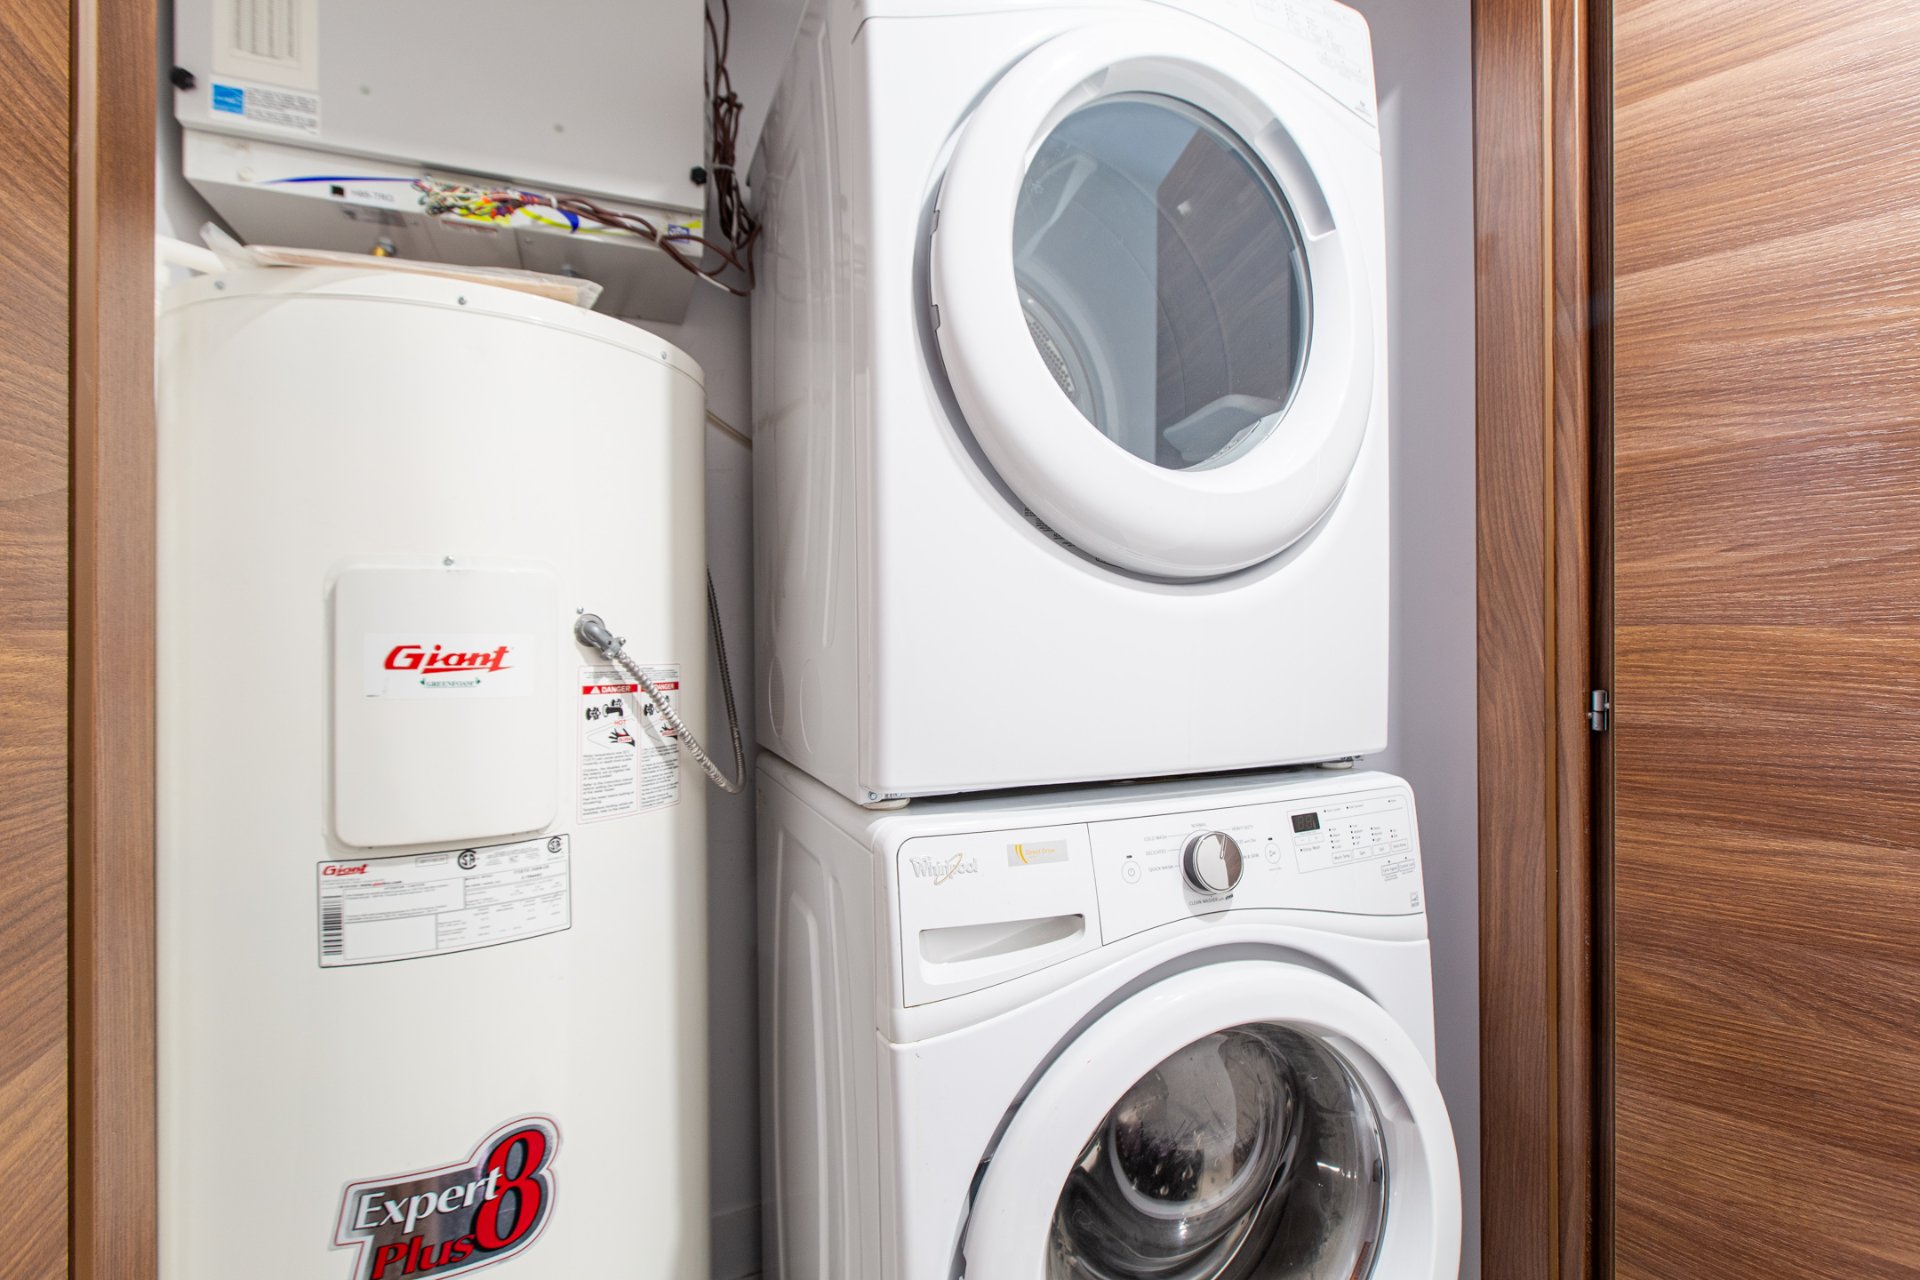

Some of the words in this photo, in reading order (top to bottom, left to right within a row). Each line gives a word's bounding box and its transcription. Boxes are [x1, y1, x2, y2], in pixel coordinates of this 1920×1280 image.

[384, 644, 512, 674] Giant
[602, 684, 631, 694] DANGER
[322, 863, 368, 876] Giant
[909, 853, 978, 885] Whirlpool
[354, 1166, 503, 1234] Expert
[472, 1128, 547, 1251] 8
[370, 1232, 478, 1280] Plus
